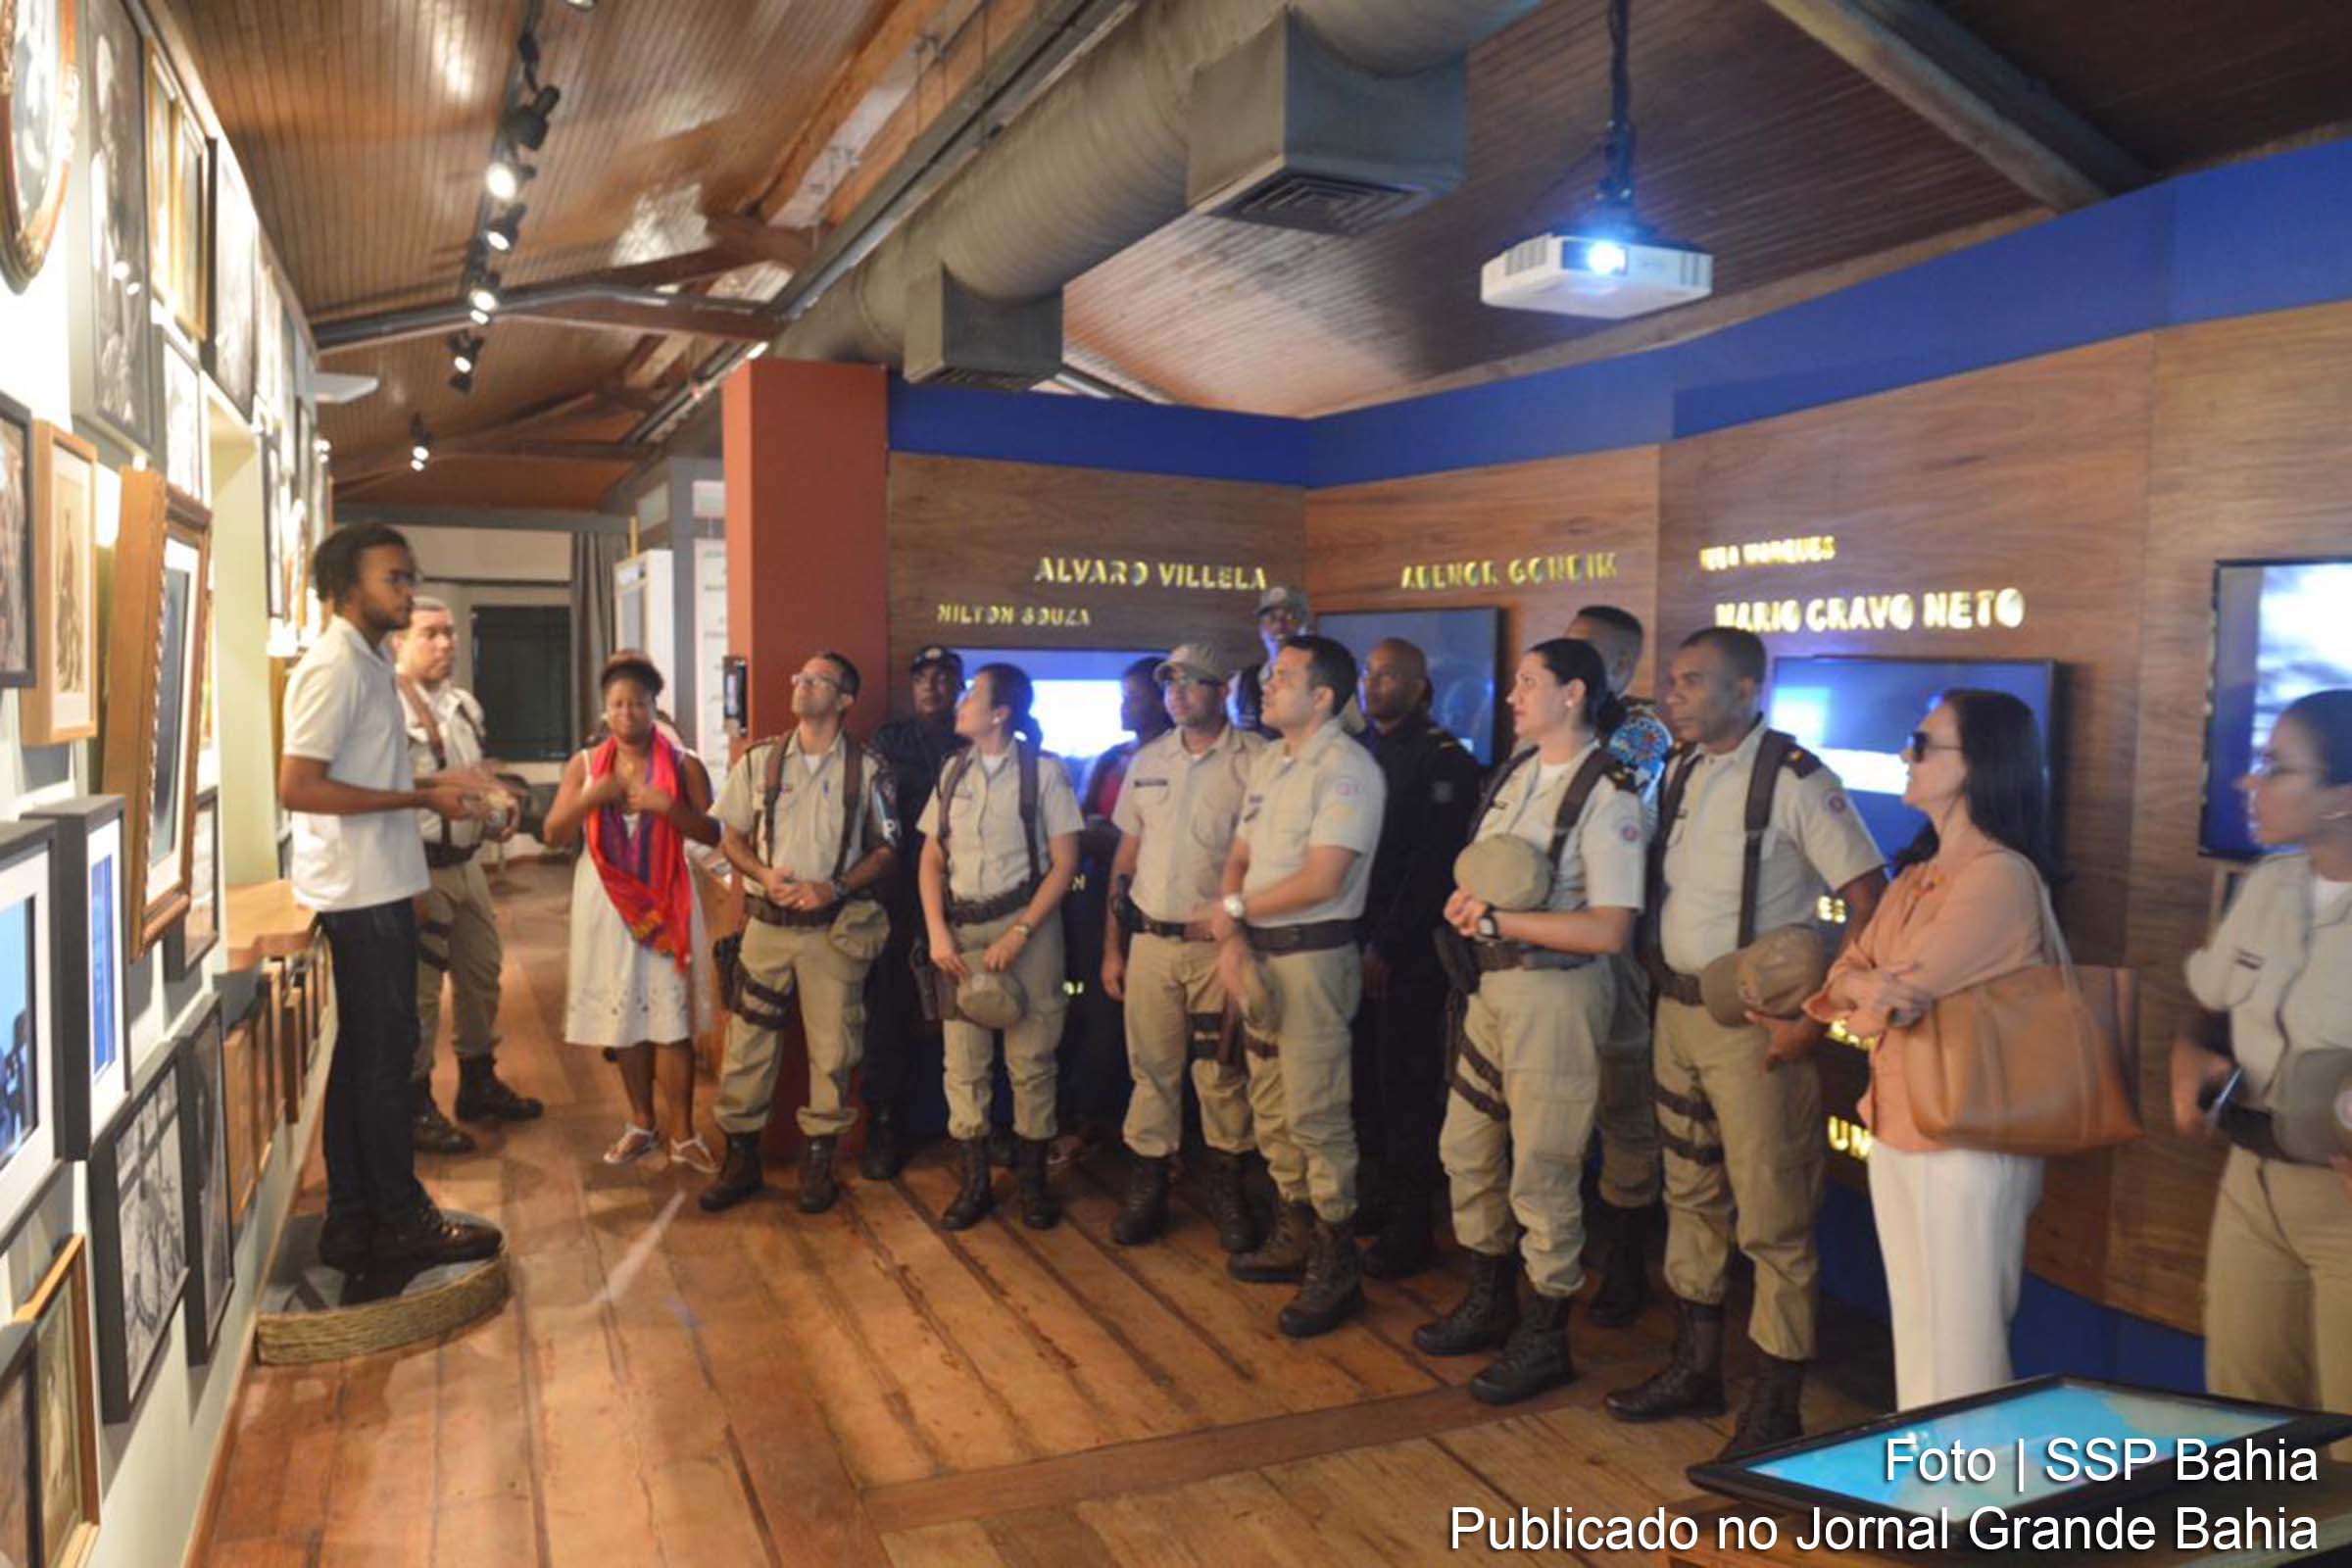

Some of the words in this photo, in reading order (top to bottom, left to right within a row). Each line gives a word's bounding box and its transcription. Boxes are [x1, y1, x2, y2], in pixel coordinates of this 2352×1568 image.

[1034, 556, 1150, 587] ALVARO
[1158, 562, 1268, 591] VILLELA
[937, 603, 1015, 625] NILTON
[1715, 599, 1802, 634] MARIO
[1805, 593, 1914, 632] CRAVO
[1923, 587, 2026, 630] NETO
